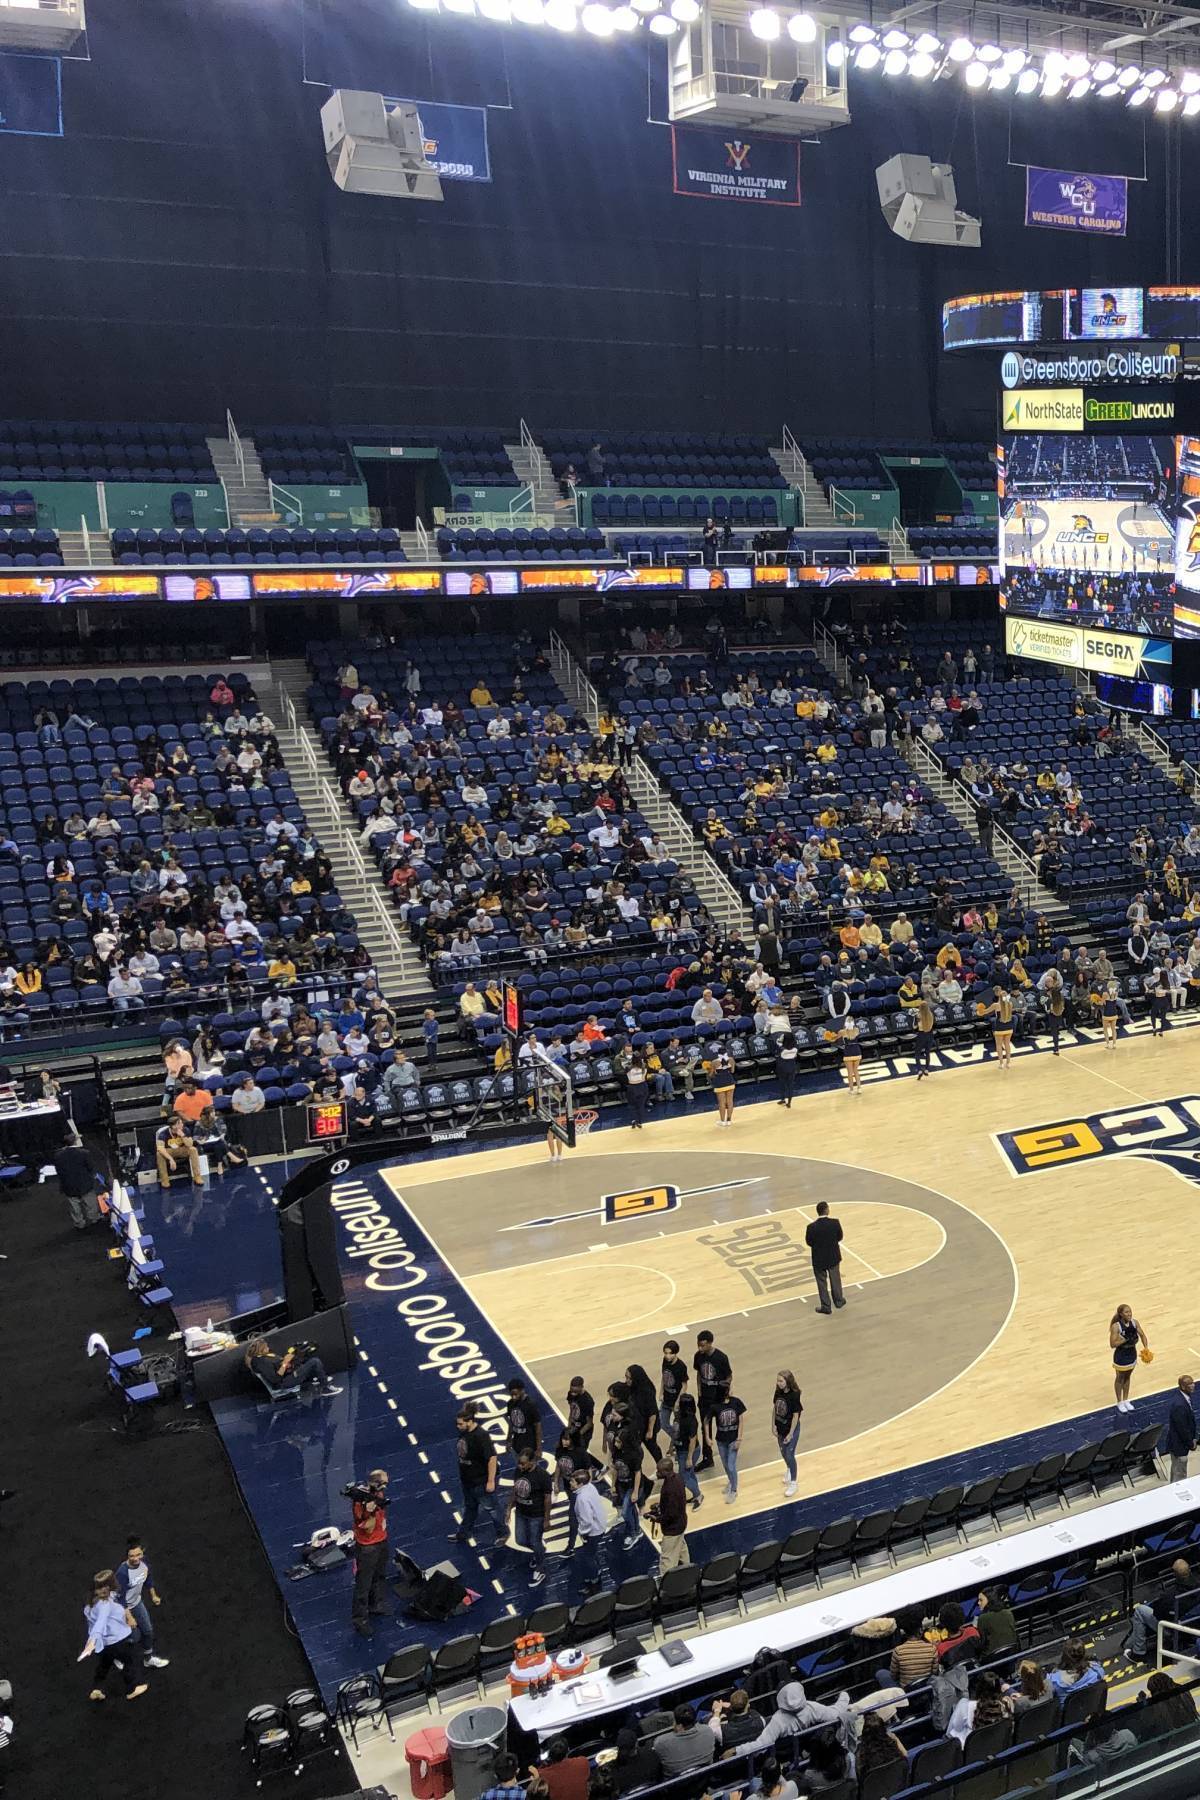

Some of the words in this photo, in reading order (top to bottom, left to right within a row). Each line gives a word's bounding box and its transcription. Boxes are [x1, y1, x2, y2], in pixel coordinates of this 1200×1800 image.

[688, 169, 736, 185] VIRGINIA
[737, 175, 788, 190] MILITARY
[710, 184, 767, 199] INSTITUTE
[1059, 183, 1095, 214] WCU
[1032, 211, 1076, 226] WESTERN
[1078, 216, 1122, 229] CAROLINA
[1022, 353, 1102, 380] Greensboro
[1106, 351, 1177, 377] Coliseum
[1025, 401, 1083, 421] NorthState
[1085, 399, 1132, 422] GREEN
[1131, 402, 1175, 419] LINCOLN
[1056, 531, 1109, 544] UNCG
[1029, 629, 1074, 649] ticketmaster
[1086, 639, 1135, 661] SEGRA
[318, 1105, 342, 1118] 7:02
[431, 1130, 467, 1143] SPALDING
[330, 1180, 427, 1291] Coliseum
